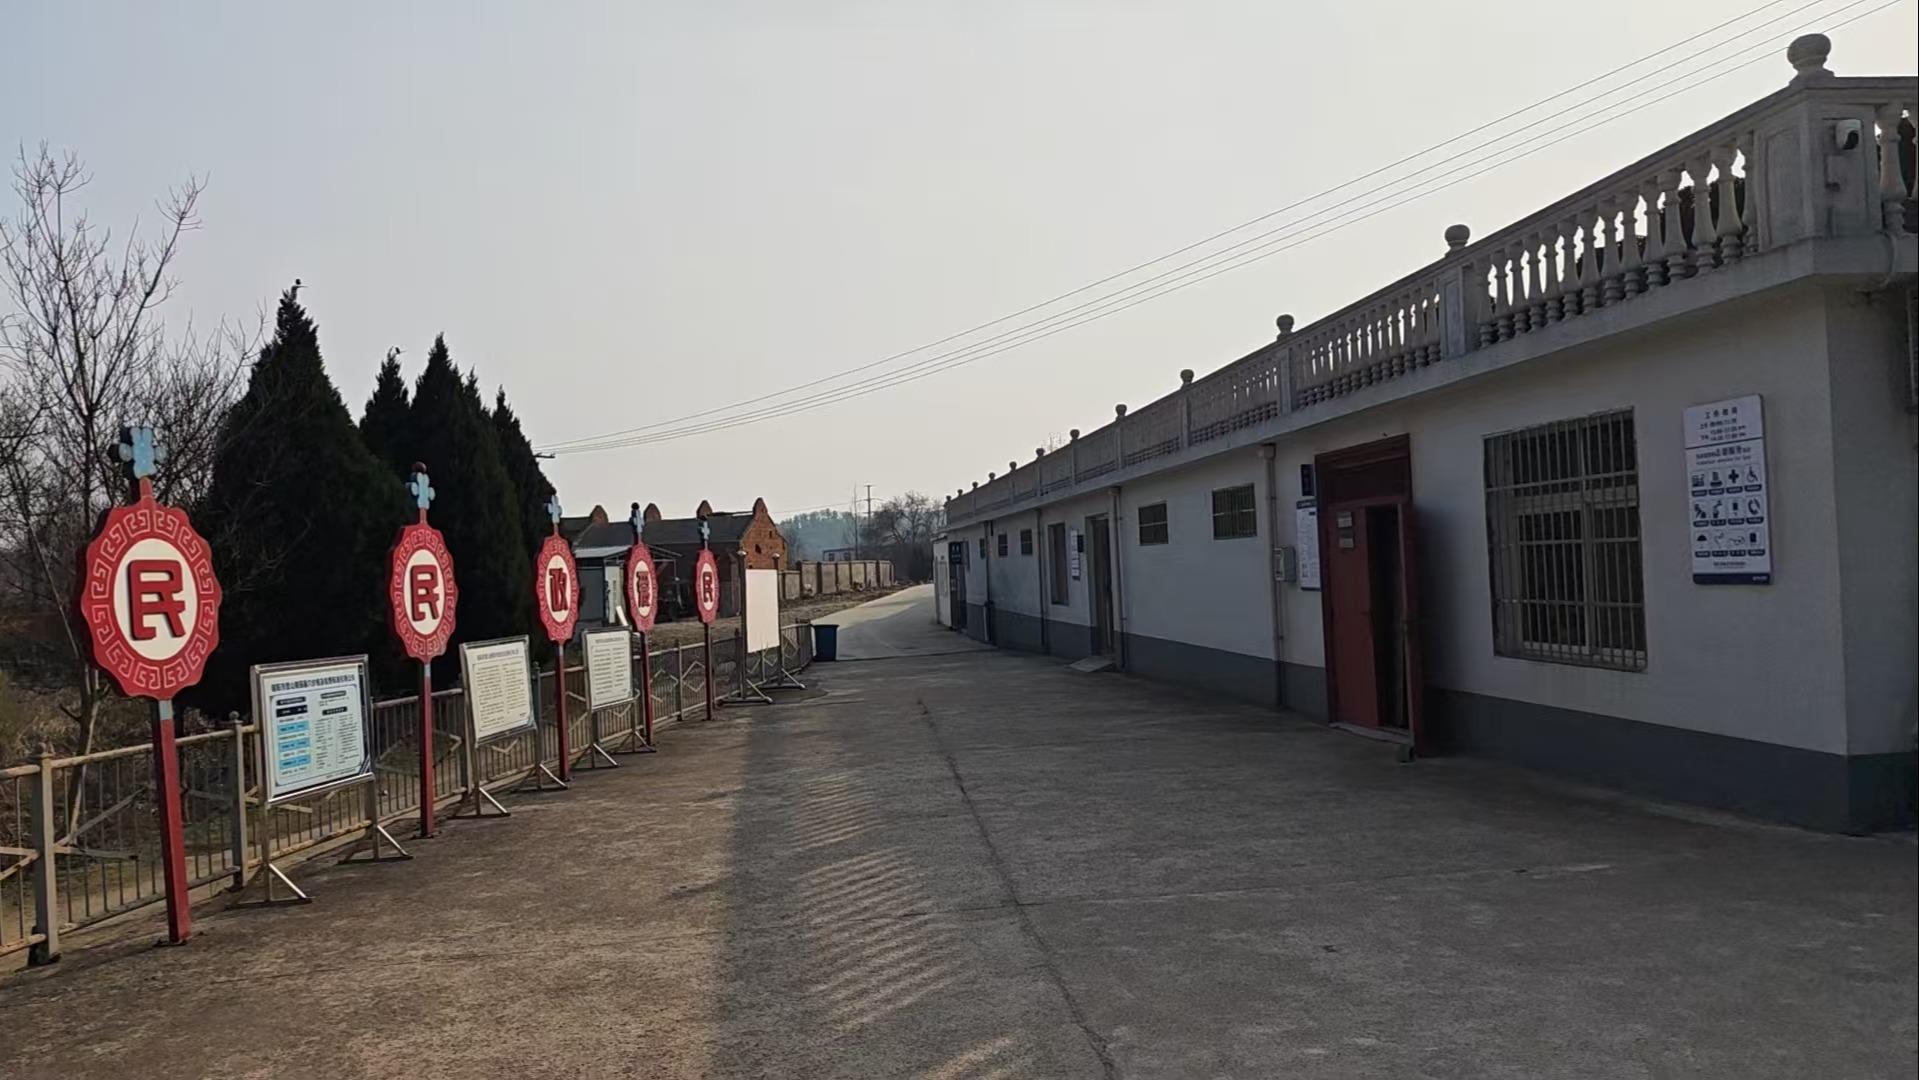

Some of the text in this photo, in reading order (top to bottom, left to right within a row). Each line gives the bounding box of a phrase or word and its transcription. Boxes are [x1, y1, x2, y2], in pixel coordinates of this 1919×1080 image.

[127, 559, 186, 640] 民
[410, 564, 440, 621] 民
[549, 567, 569, 612] 政
[703, 571, 713, 603] 民
